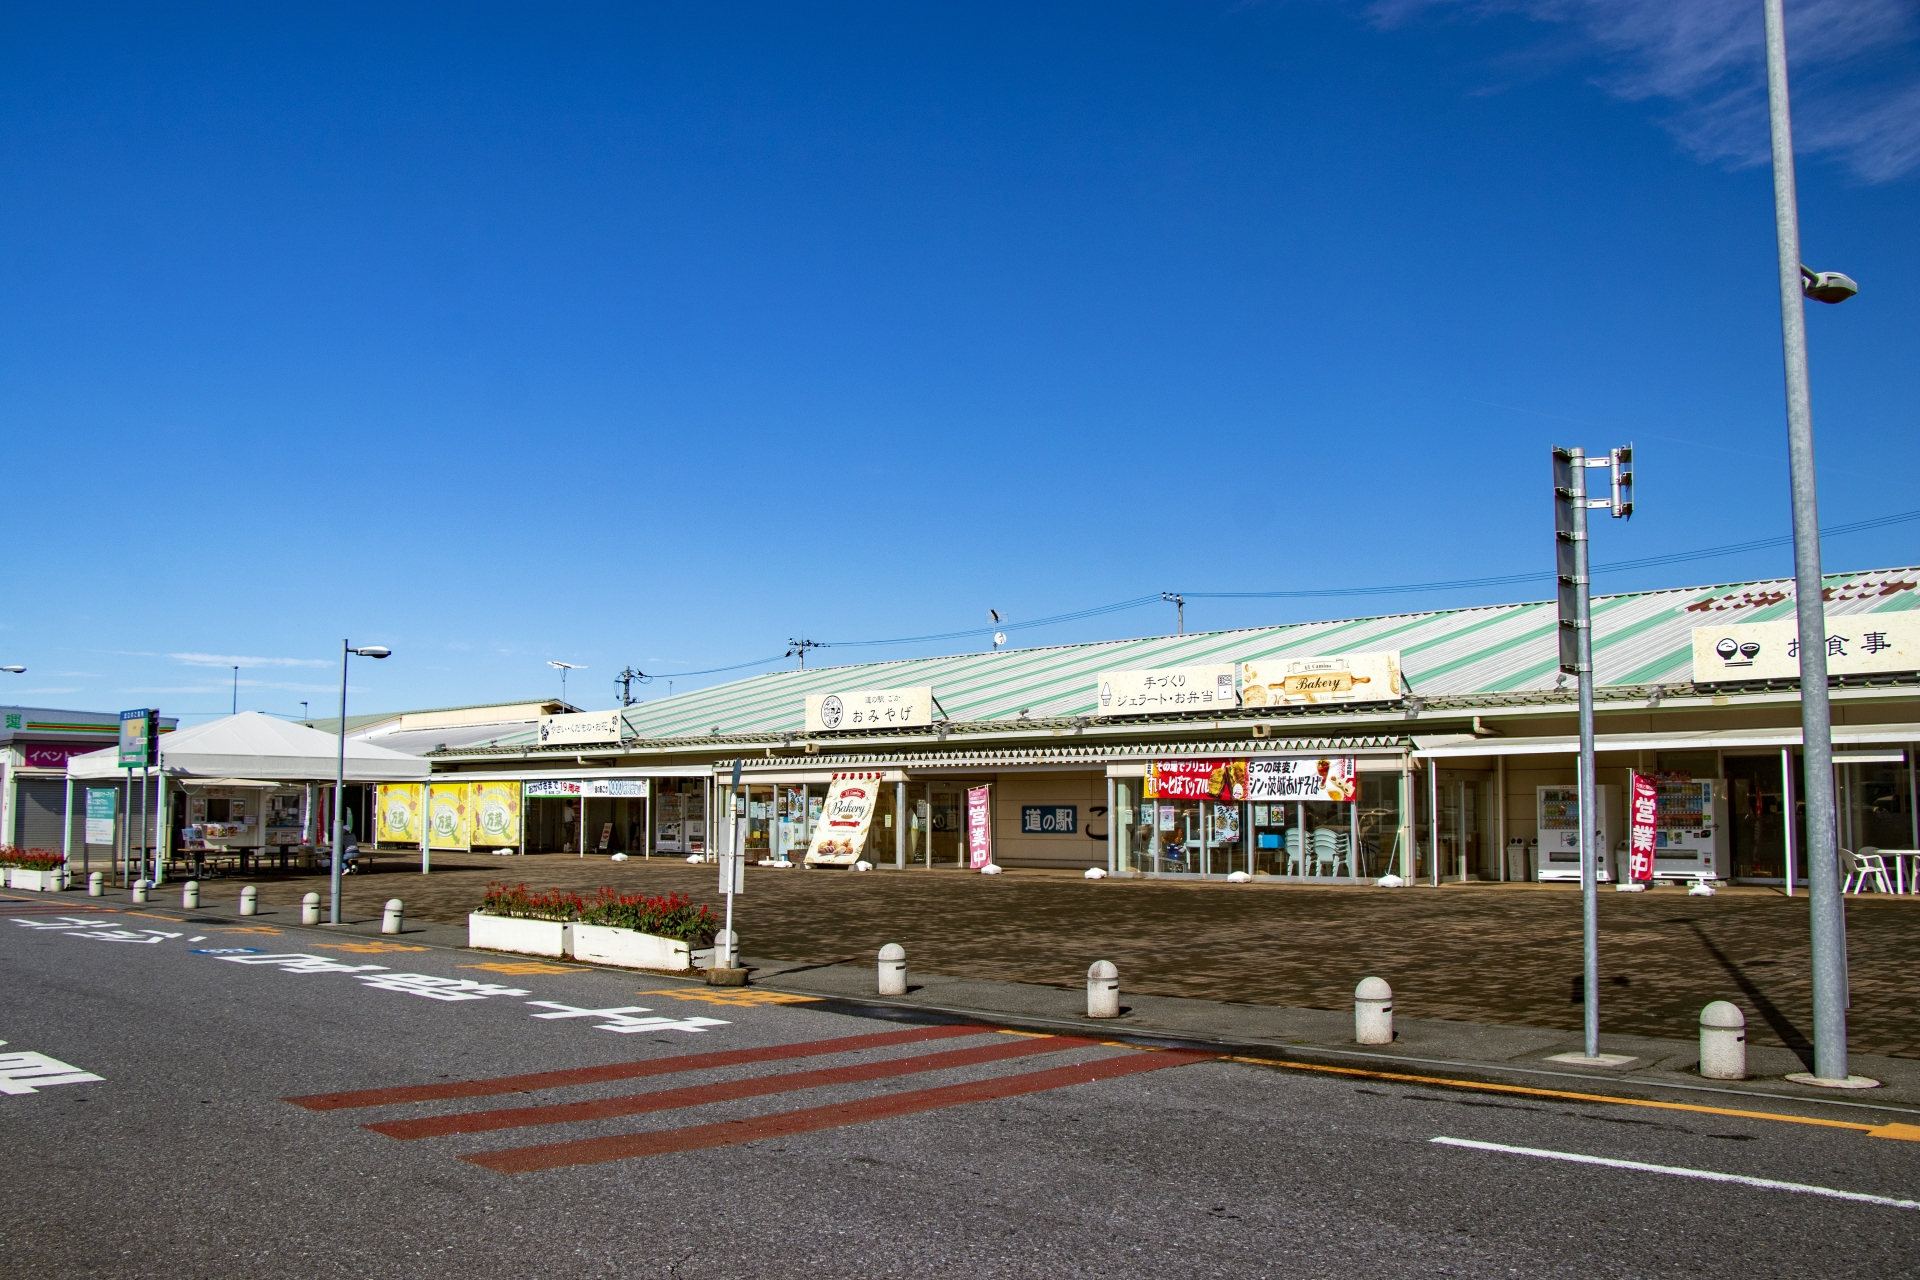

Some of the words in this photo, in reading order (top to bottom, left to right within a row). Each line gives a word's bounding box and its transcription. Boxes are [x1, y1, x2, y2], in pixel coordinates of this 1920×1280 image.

[1144, 675, 1186, 689] 手づくり
[1295, 677, 1341, 691] Bakery
[865, 695, 885, 704] 道の駅
[888, 695, 901, 703] ごか
[1117, 690, 1213, 706] ジェラート・お弁当
[852, 705, 913, 723] おみやげ
[30, 750, 84, 761] イベント
[831, 800, 866, 818] Bakery
[1025, 808, 1073, 831] 道の駅
[970, 805, 987, 867] 営業中
[1632, 796, 1656, 878] 営業中
